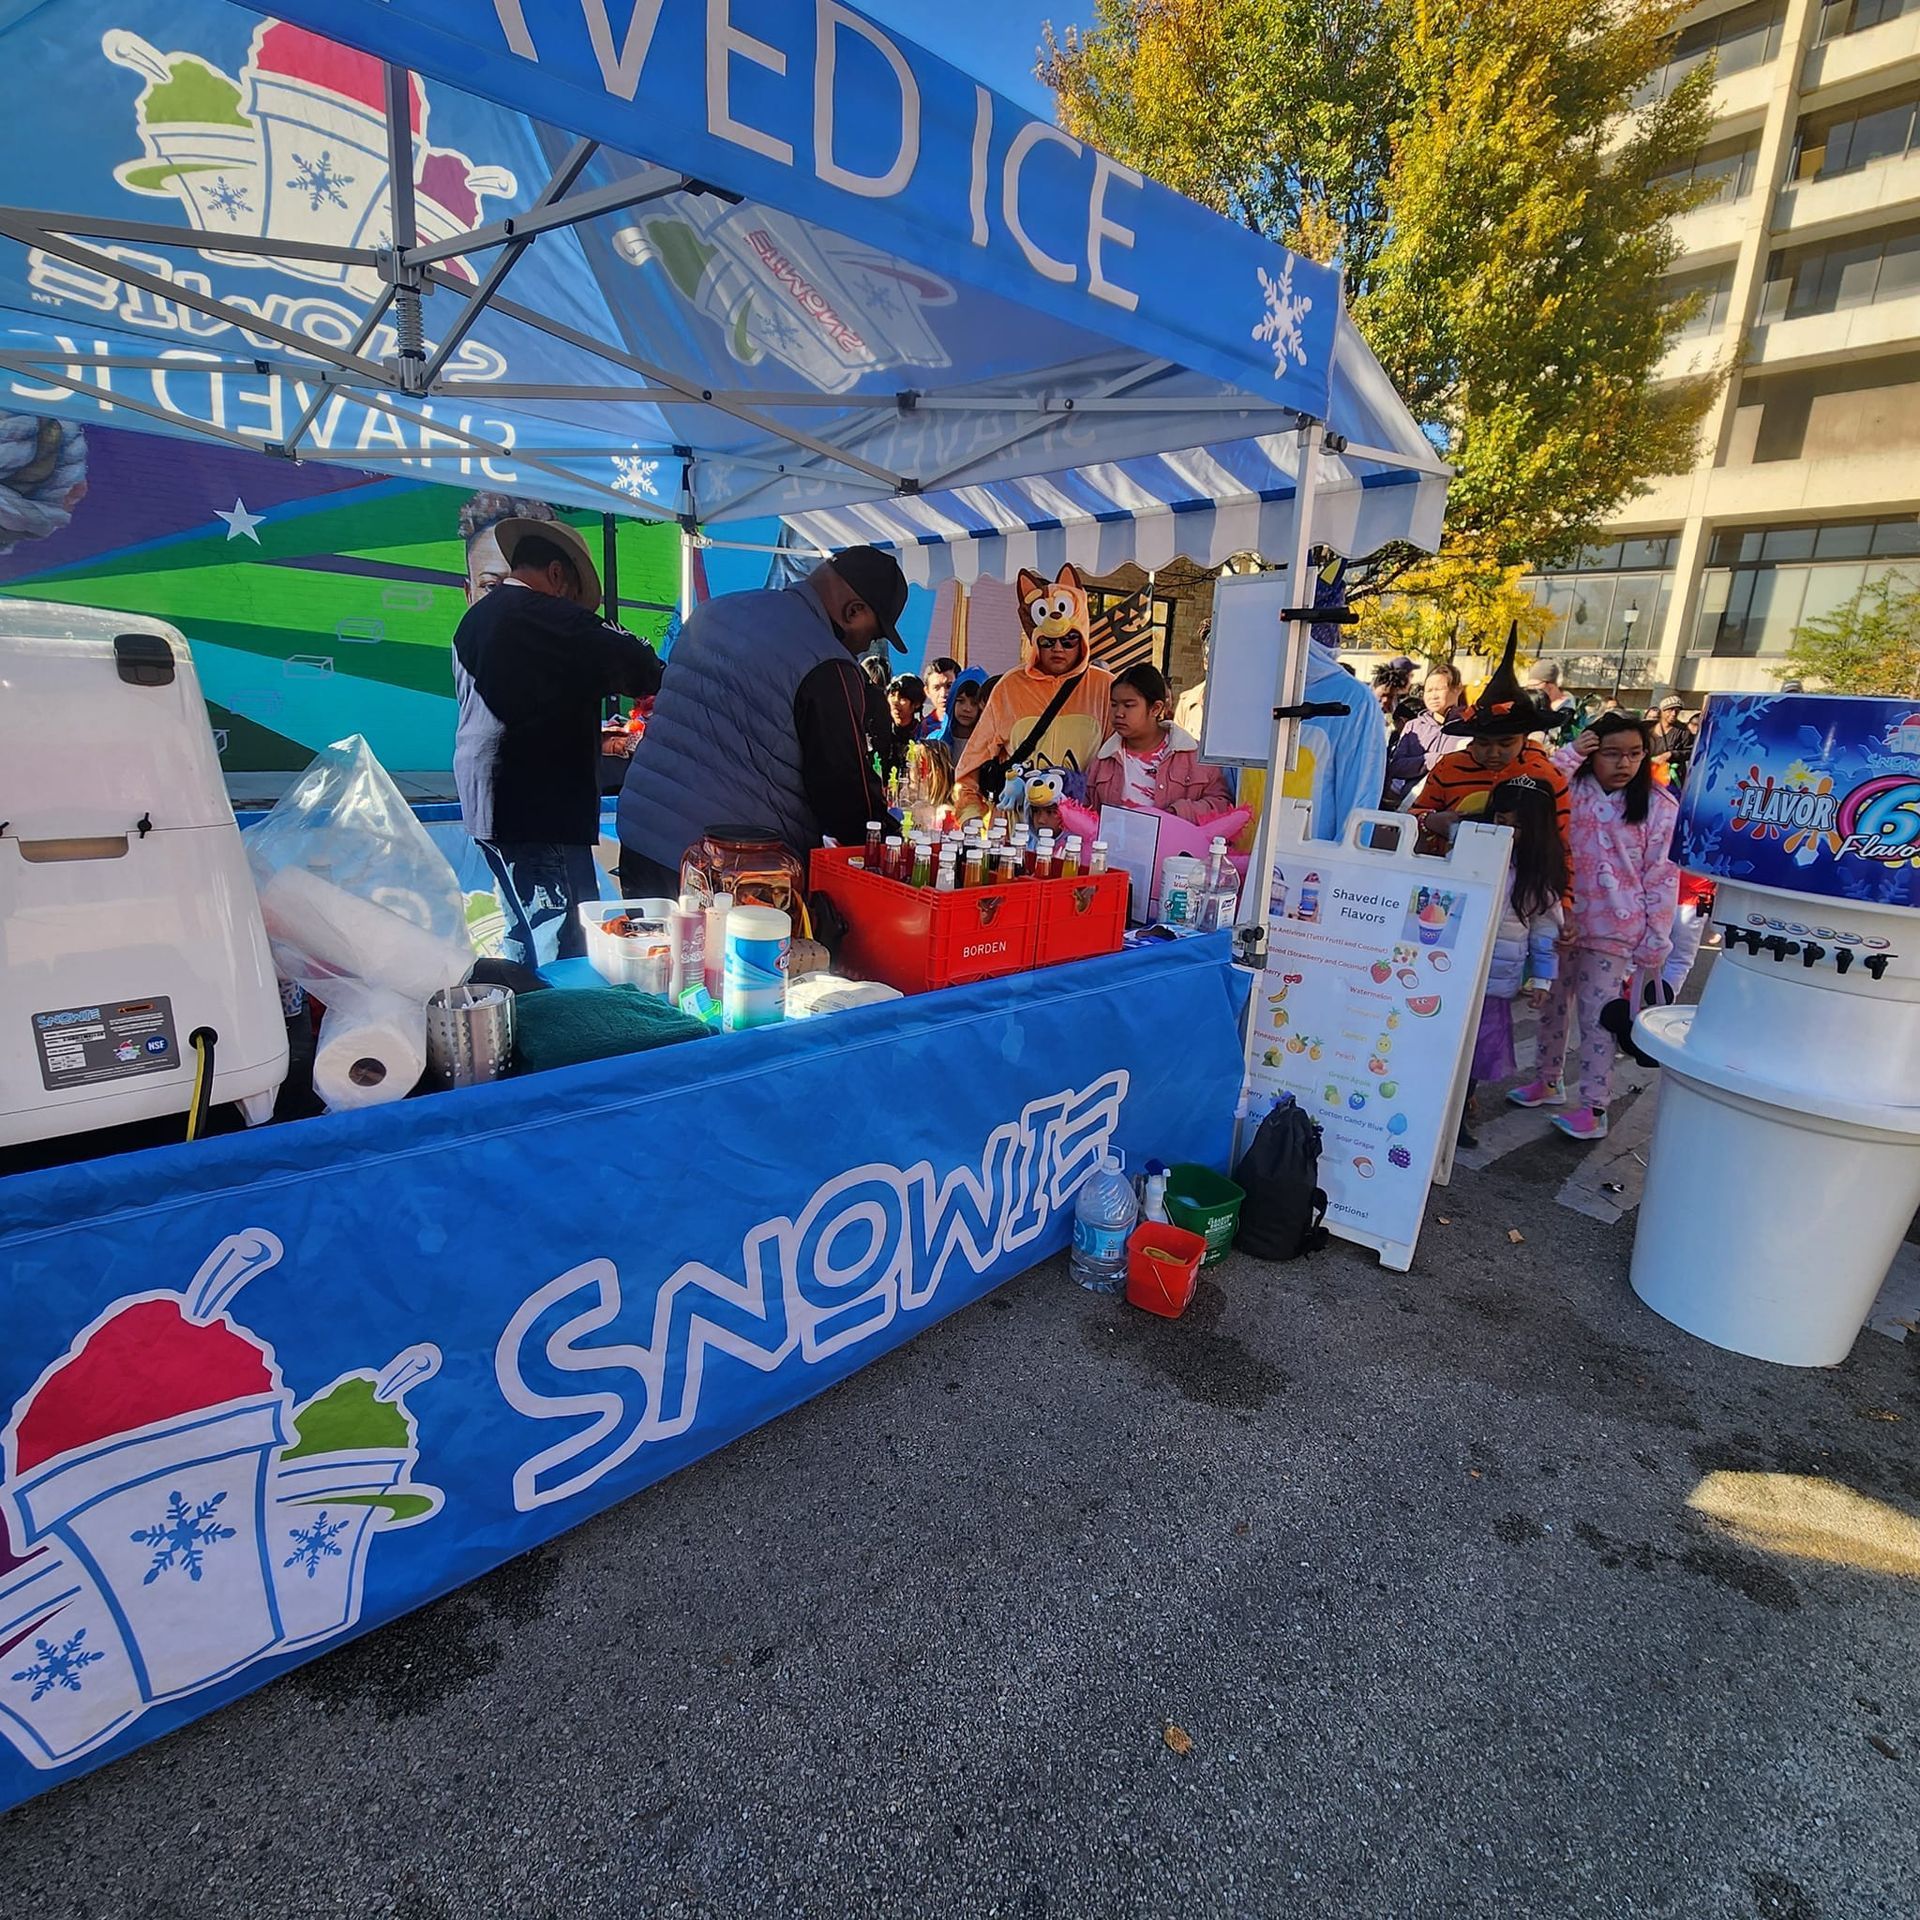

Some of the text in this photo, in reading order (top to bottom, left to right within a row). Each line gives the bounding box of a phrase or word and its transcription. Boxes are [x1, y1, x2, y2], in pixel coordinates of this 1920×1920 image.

[970, 84, 1144, 312] ICE
[1739, 783, 1920, 846] FLAVOR 6
[1834, 833, 1920, 862] Flavo
[1332, 888, 1400, 909] Shaved Ice
[1340, 906, 1386, 924] Flavors
[963, 940, 1007, 958] BORDEN
[1324, 957, 1337, 966] and
[1349, 985, 1393, 1001] Watermelon
[36, 1007, 101, 1029] SNOWIE
[147, 1039, 166, 1051] NSF
[1318, 1108, 1384, 1131] Cotton Candy Blue
[1335, 1133, 1375, 1151] Sour Grape
[1334, 1203, 1369, 1218] options!
[495, 1069, 1130, 1512] SNOWIE
